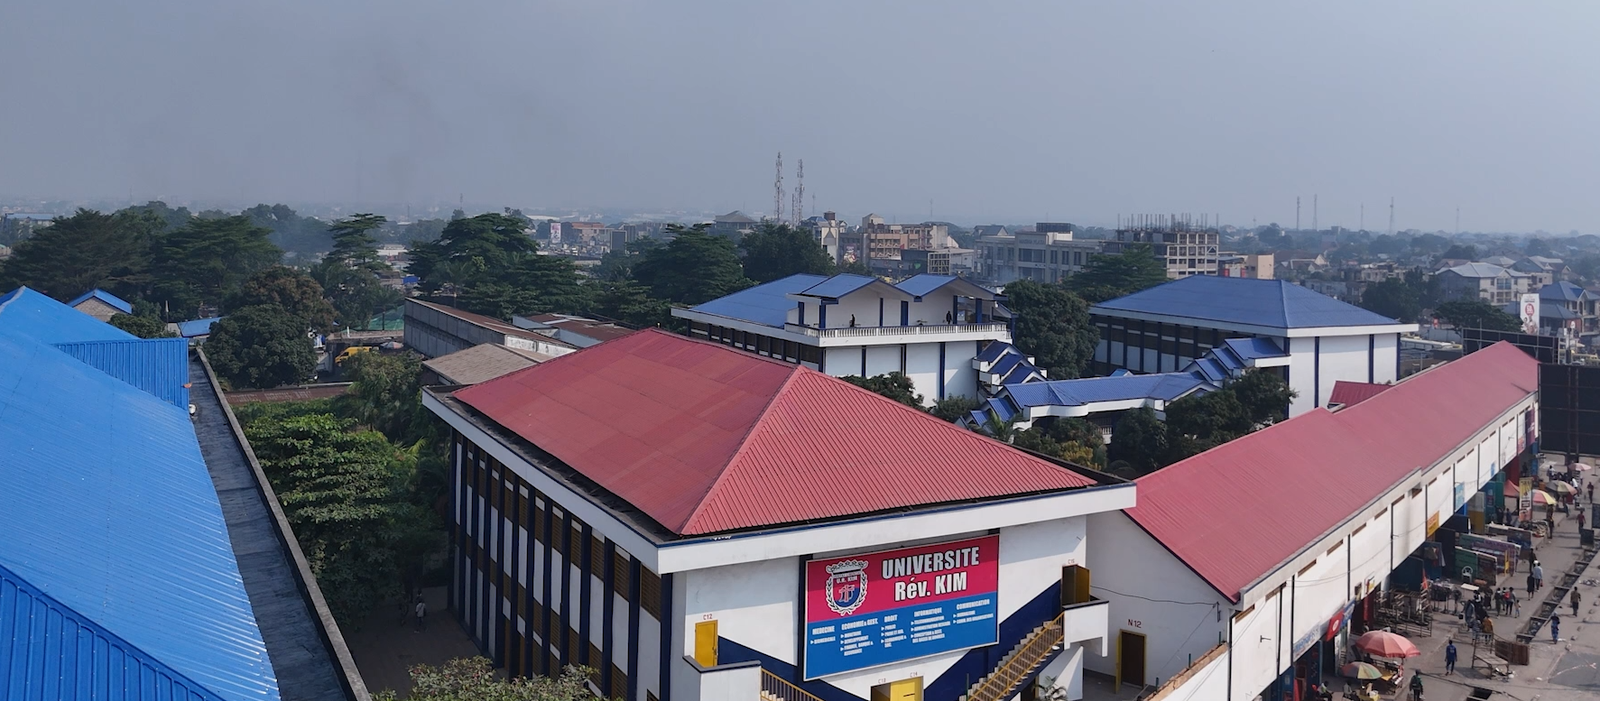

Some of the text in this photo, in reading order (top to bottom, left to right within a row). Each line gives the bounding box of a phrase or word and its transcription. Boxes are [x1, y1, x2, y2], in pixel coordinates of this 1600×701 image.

[882, 546, 980, 579] UNIVERSITE
[894, 571, 967, 601] Rév. KIM
